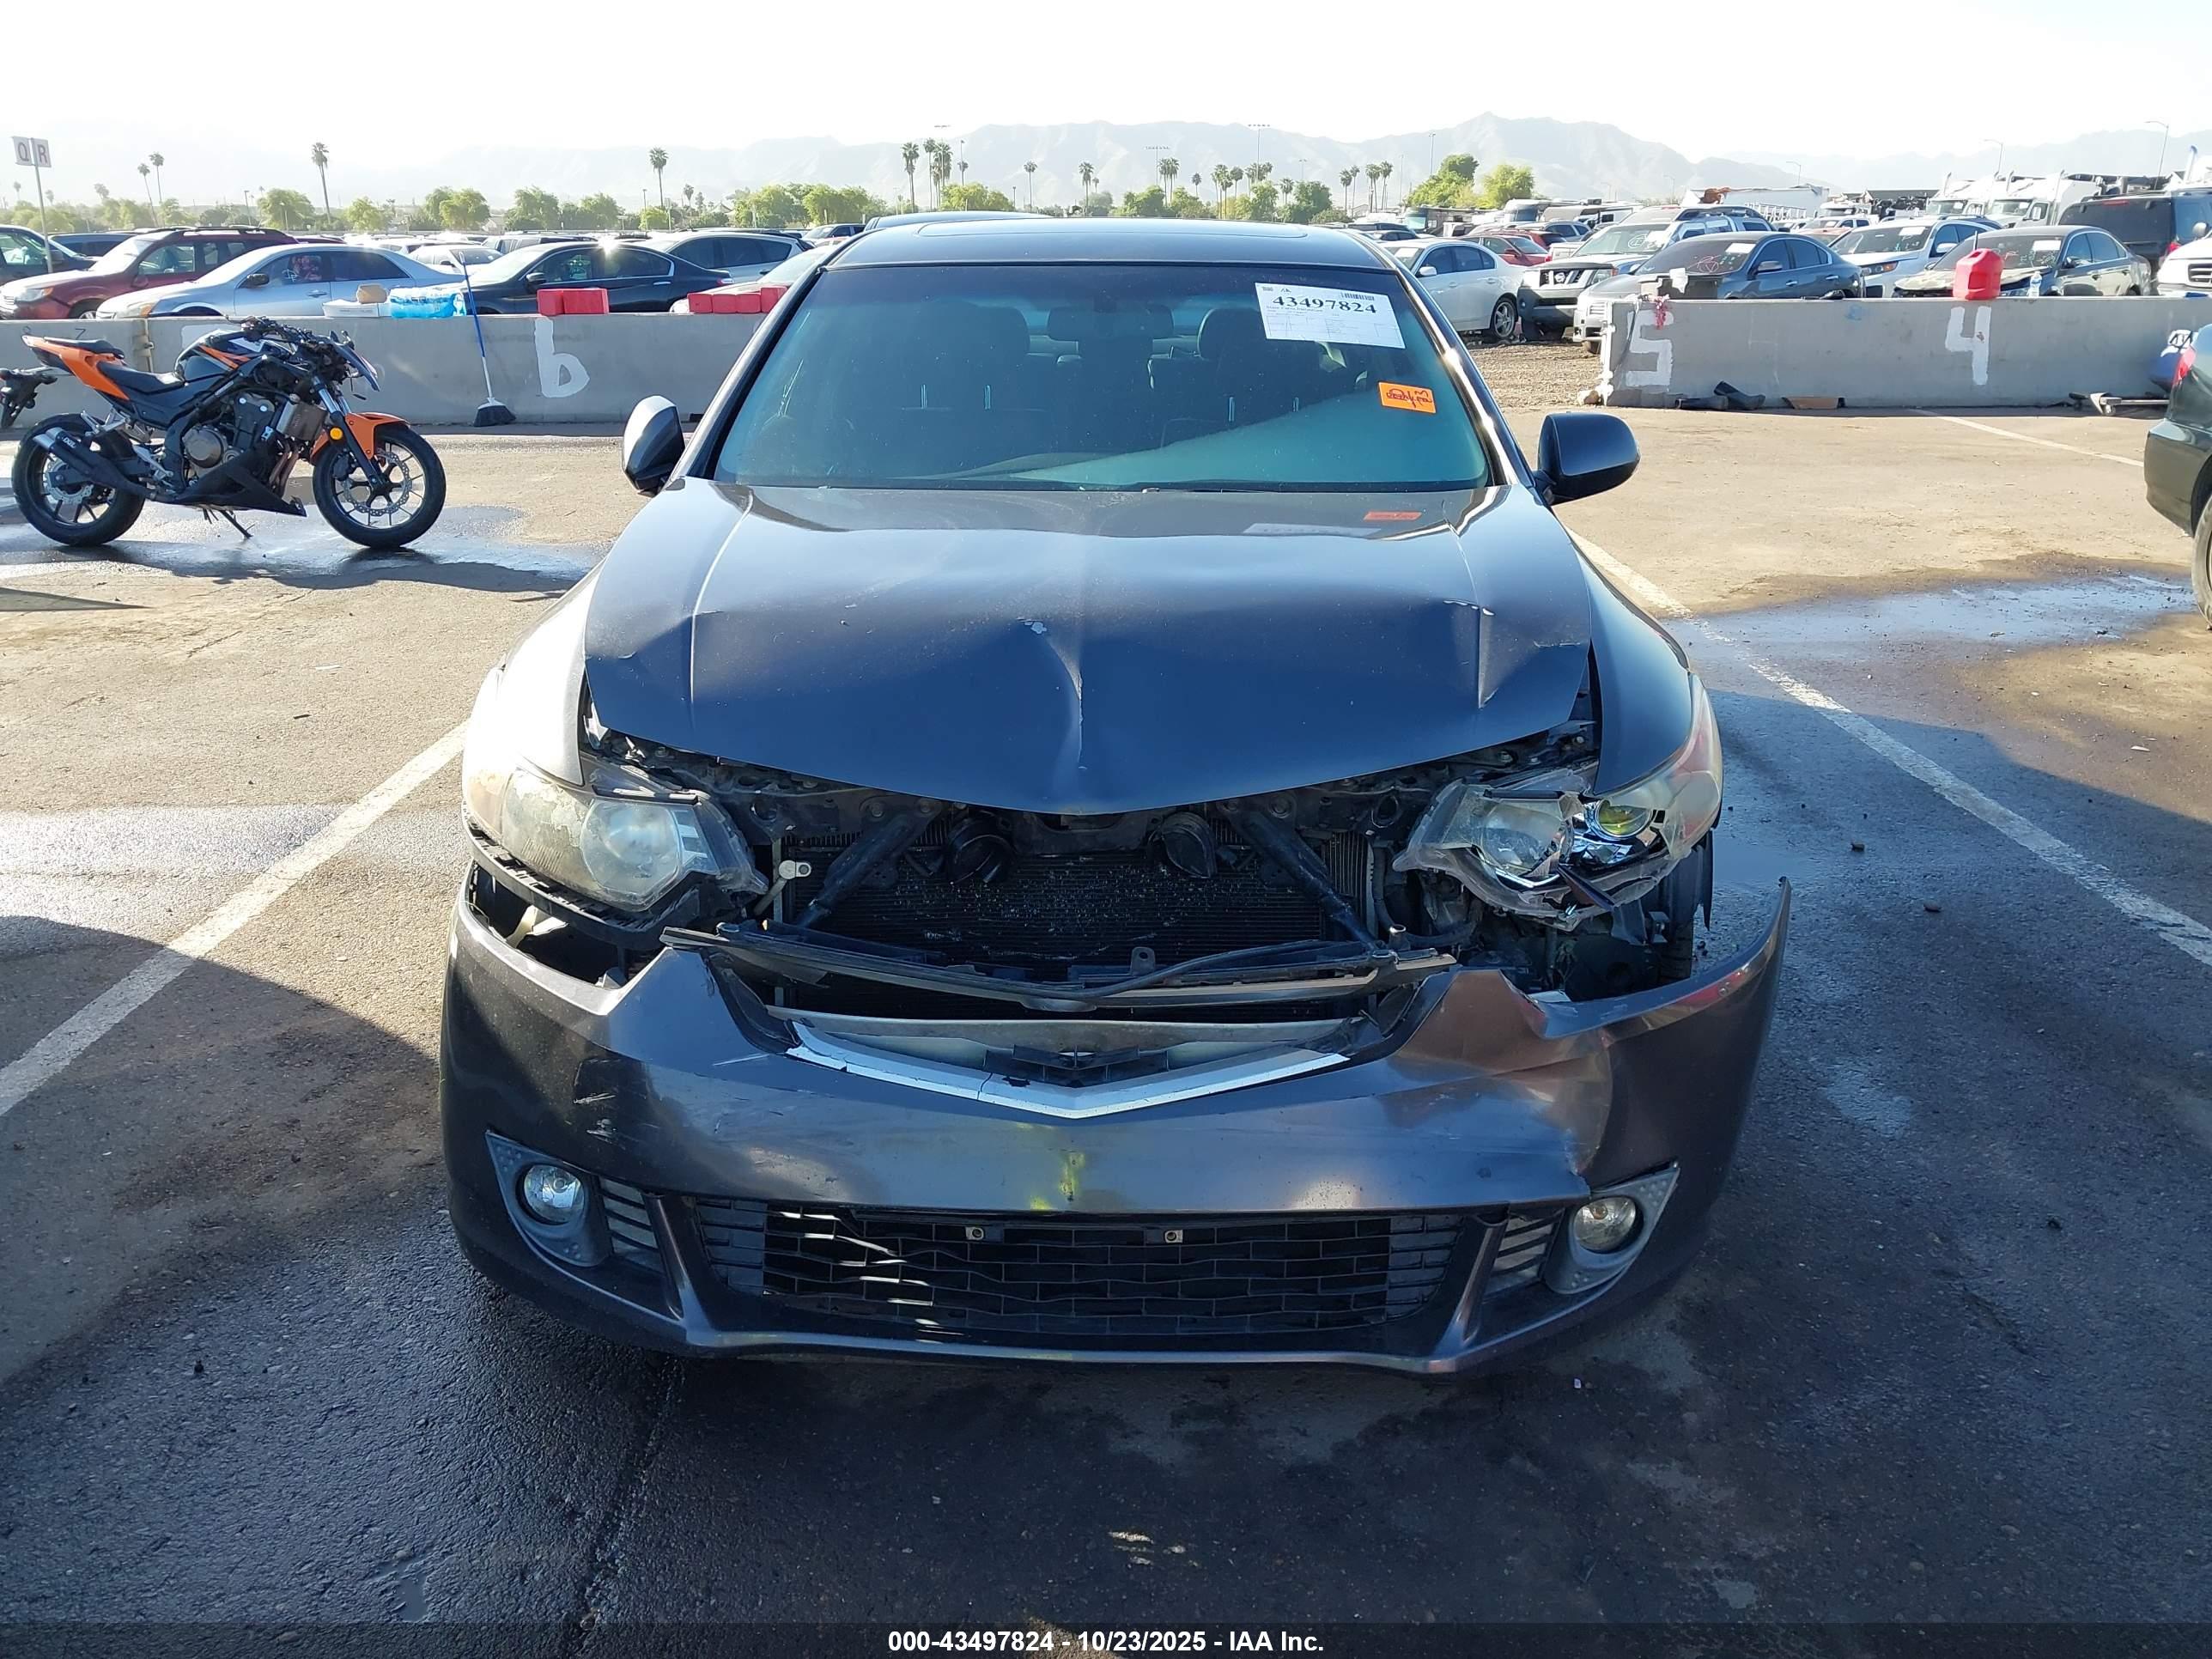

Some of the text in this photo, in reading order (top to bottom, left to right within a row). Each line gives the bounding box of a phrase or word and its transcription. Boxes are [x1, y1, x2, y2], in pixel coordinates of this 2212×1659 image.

[17, 142, 48, 164] Q R
[1273, 295, 1377, 313] 43497824
[1626, 308, 1674, 387] 5
[1945, 305, 1992, 386] 4
